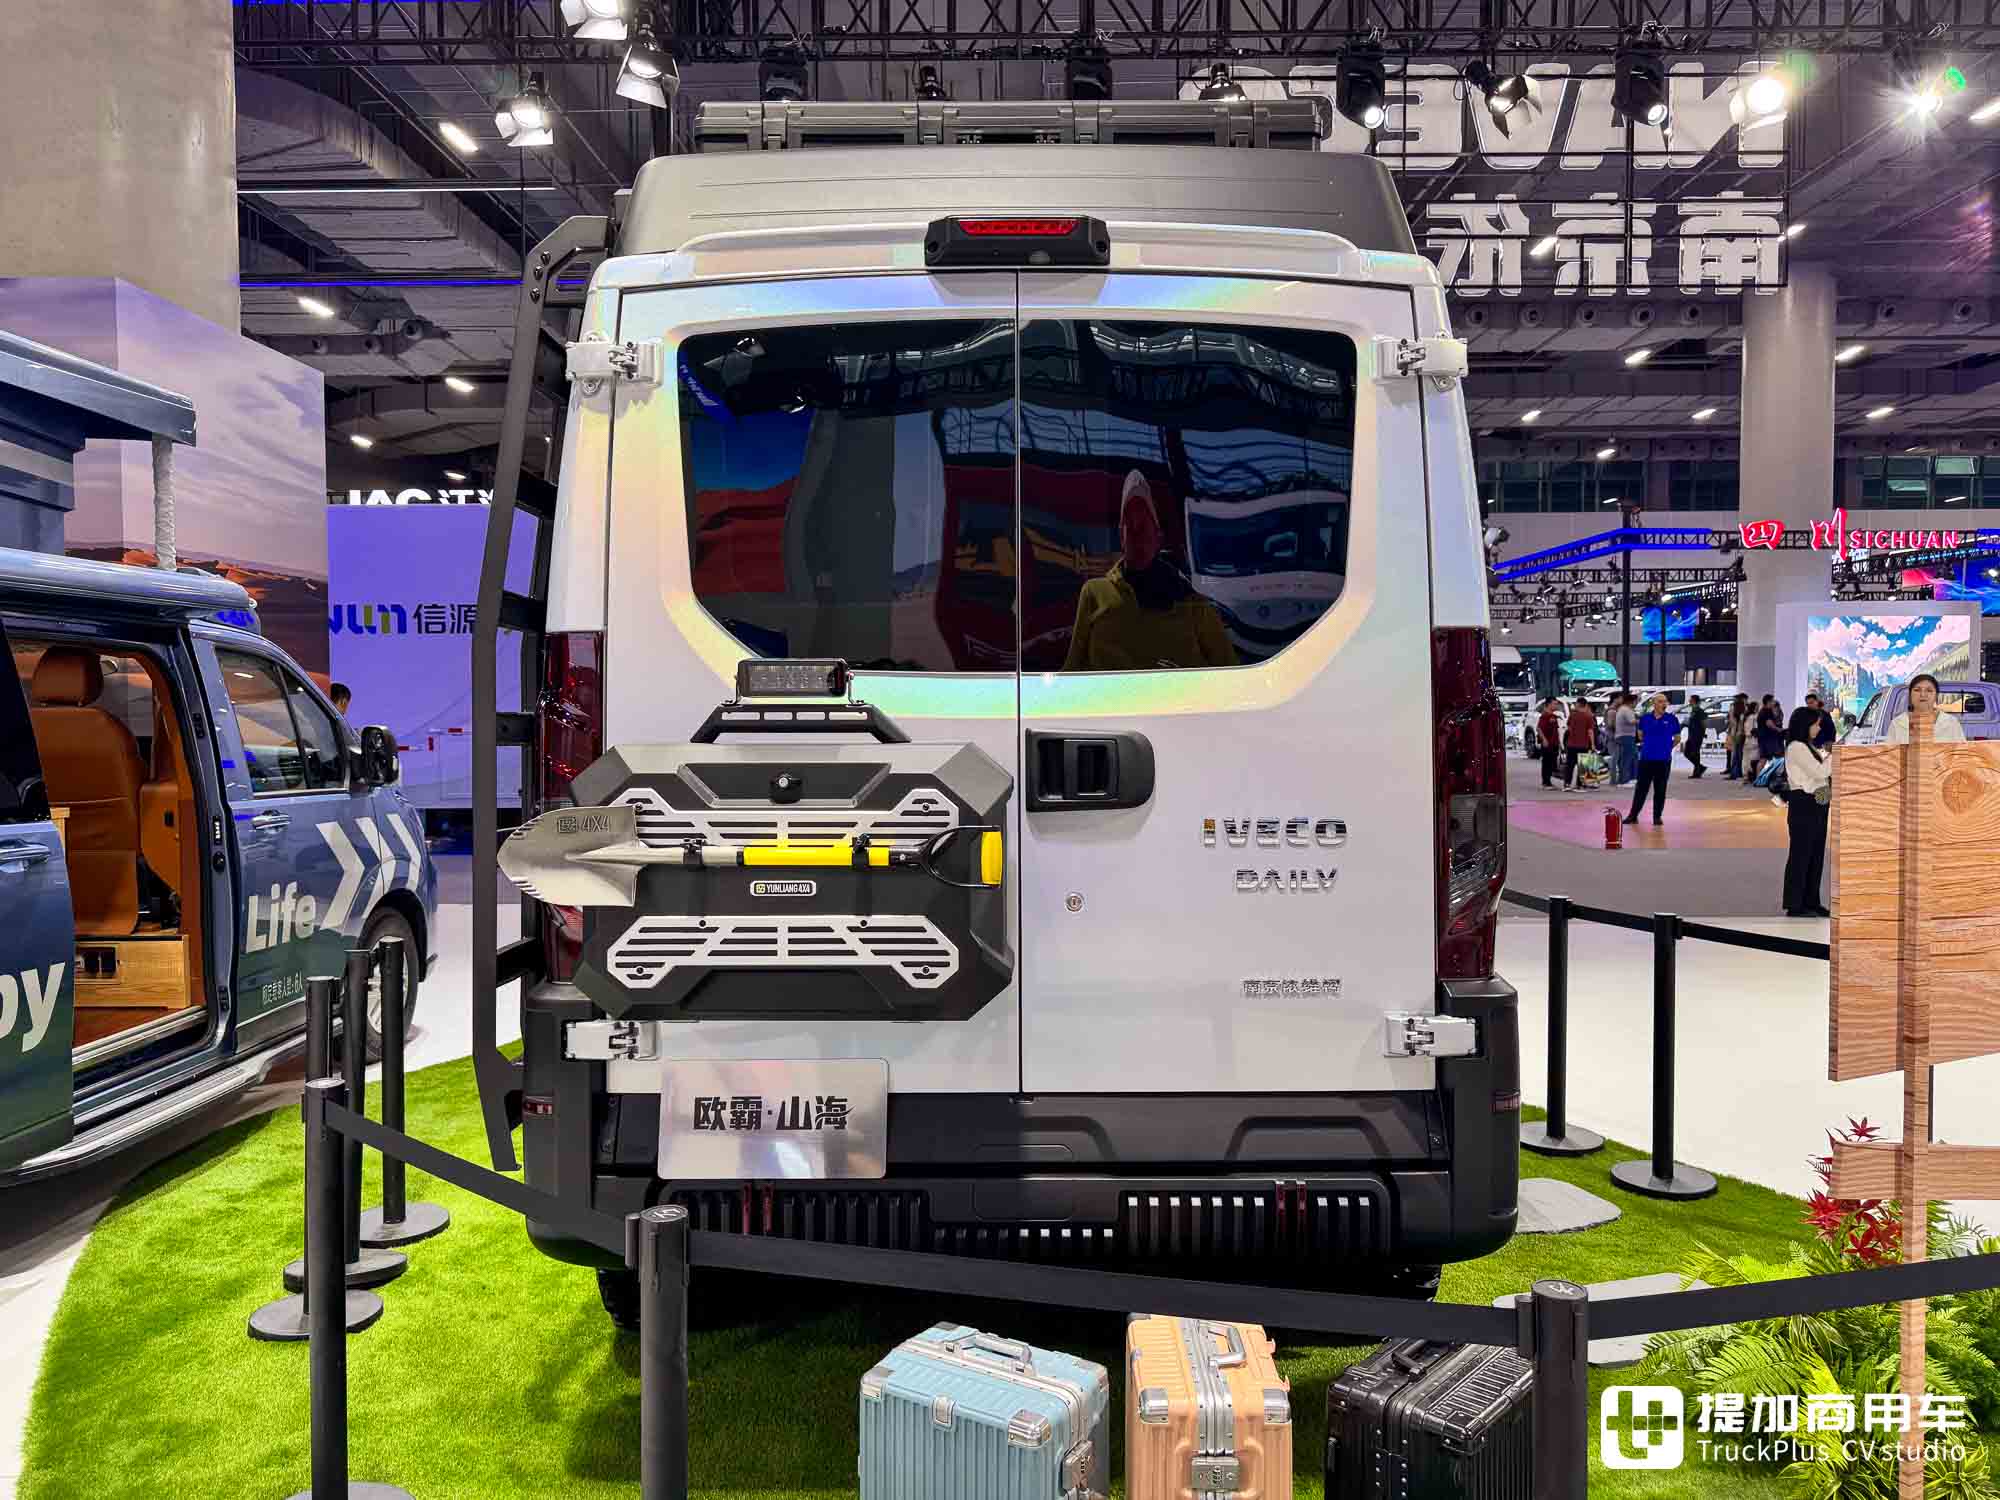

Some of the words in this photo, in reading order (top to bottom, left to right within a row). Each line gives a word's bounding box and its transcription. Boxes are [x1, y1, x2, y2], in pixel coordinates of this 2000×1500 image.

[1849, 530, 1959, 549] SICHUAN
[1203, 817, 1348, 847] IVECO
[766, 883, 798, 894] YUNLIANG
[1236, 868, 1337, 891] DAILY
[246, 881, 316, 953] Life
[693, 1095, 857, 1131] 欧霸·山海
